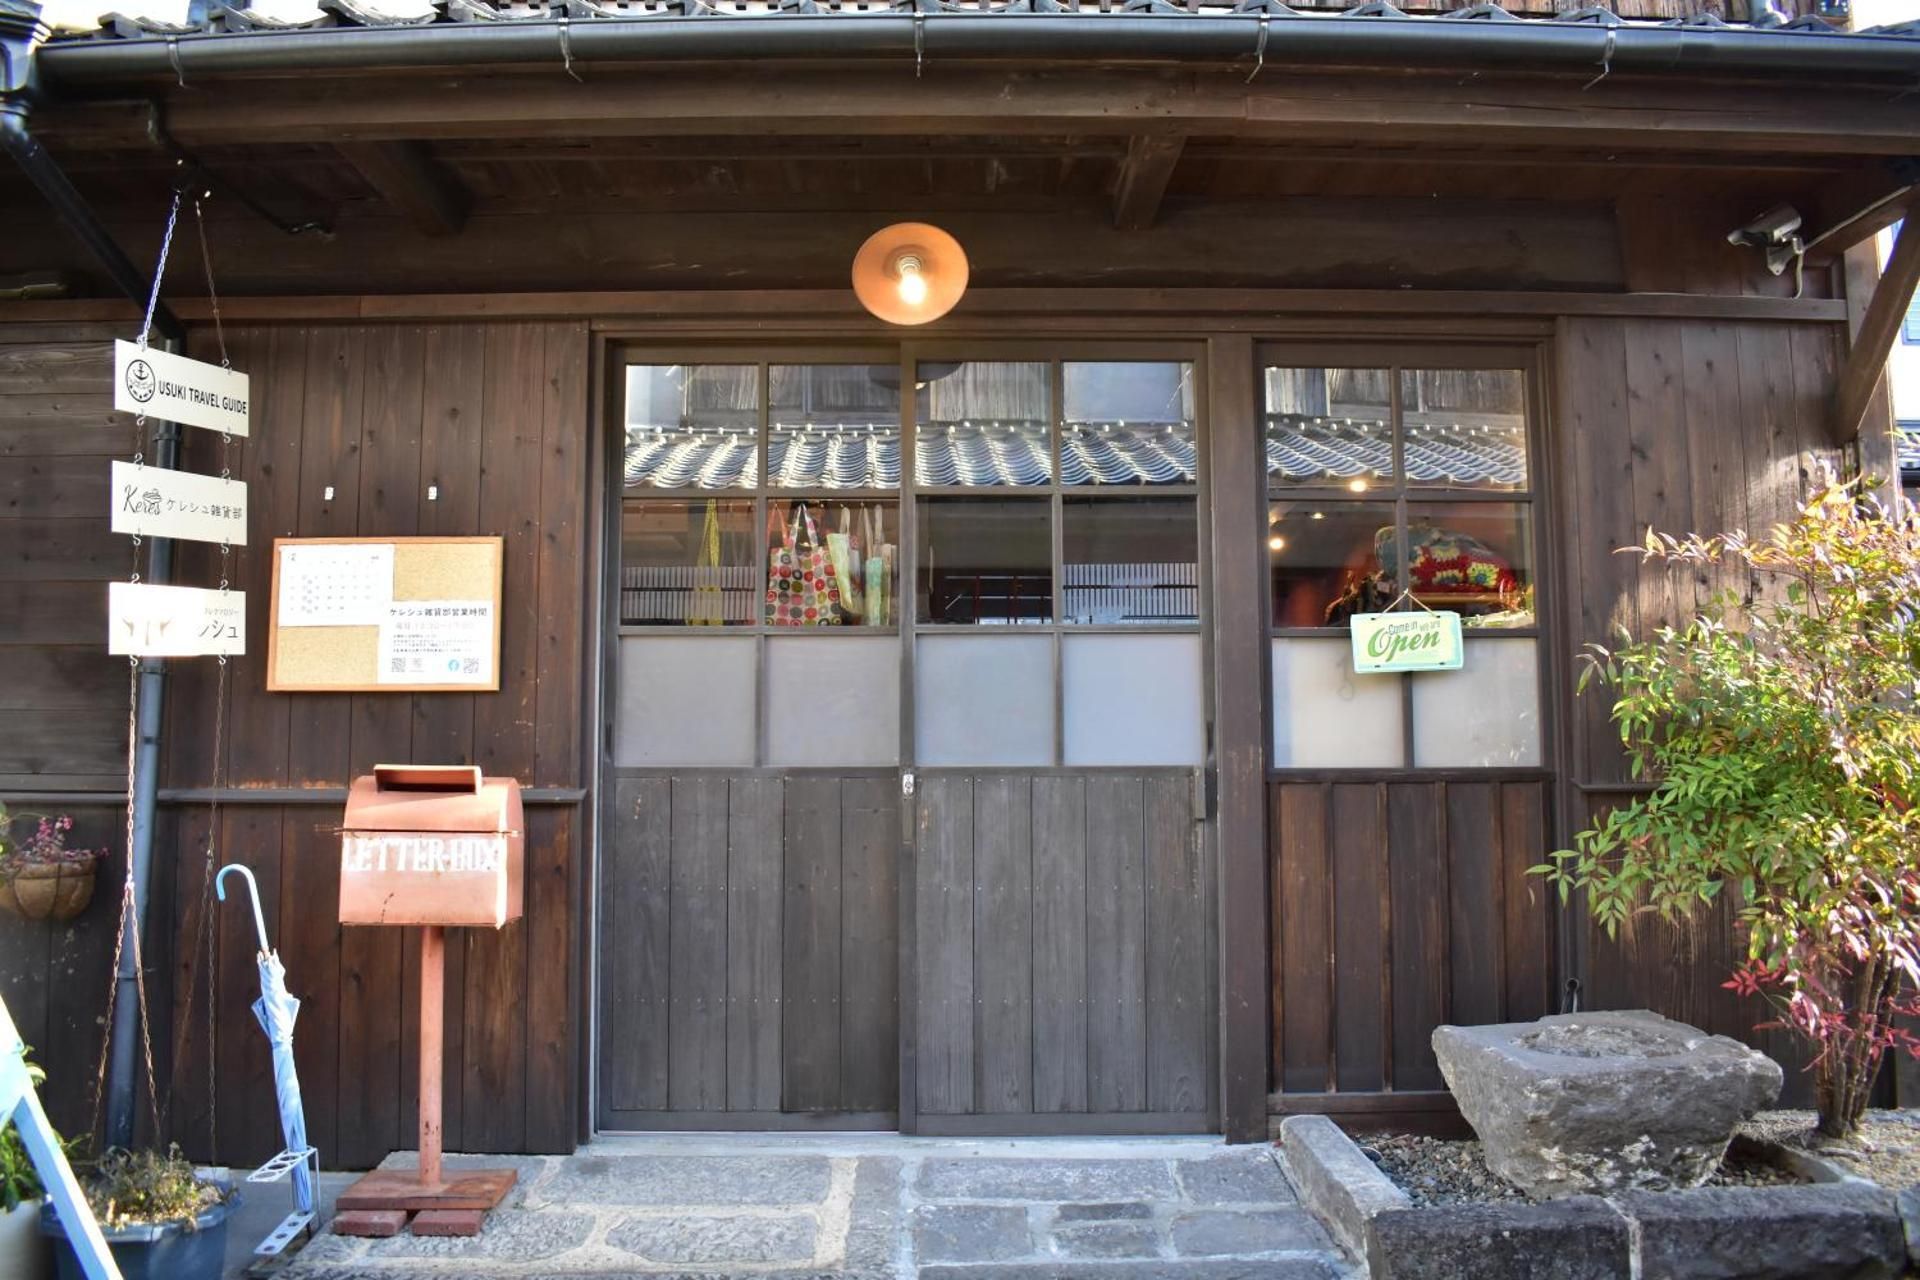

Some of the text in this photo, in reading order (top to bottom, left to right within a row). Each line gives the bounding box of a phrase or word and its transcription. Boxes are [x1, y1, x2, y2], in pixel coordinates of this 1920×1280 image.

[159, 380, 247, 415] USUKI TRAVEL GUIDE
[166, 498, 243, 520] ケレシュ雑貨部
[1367, 627, 1441, 663] Open
